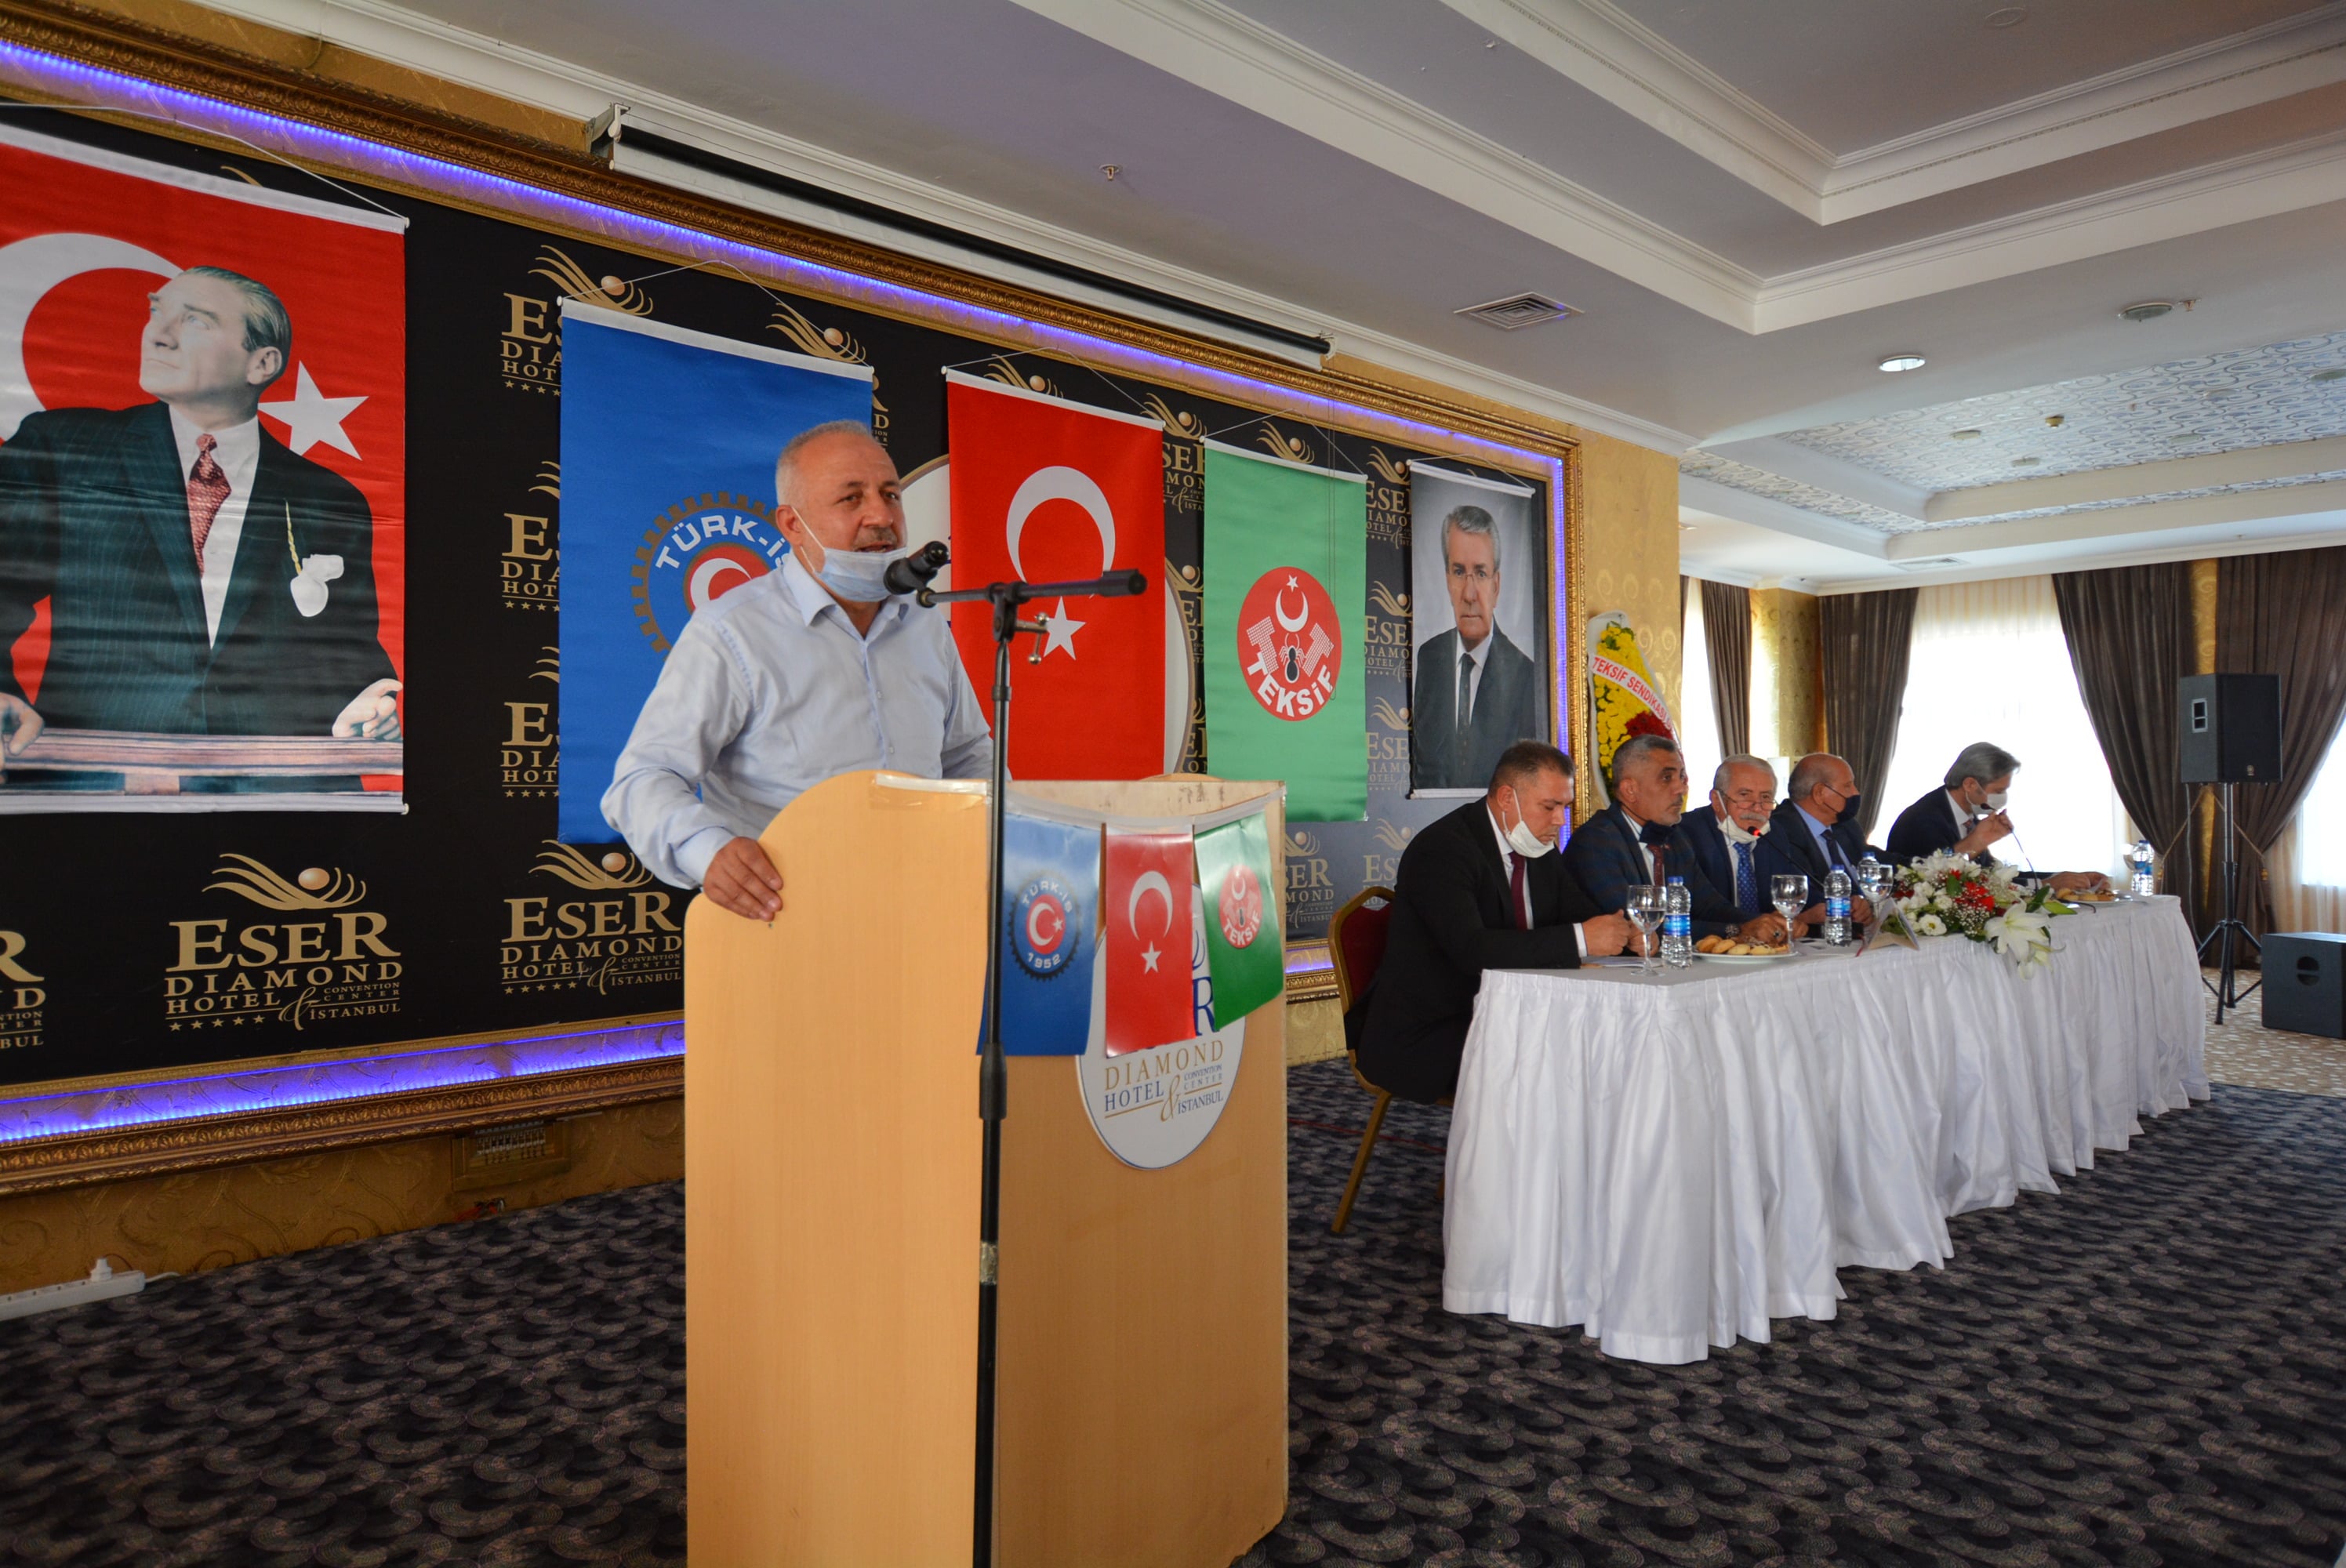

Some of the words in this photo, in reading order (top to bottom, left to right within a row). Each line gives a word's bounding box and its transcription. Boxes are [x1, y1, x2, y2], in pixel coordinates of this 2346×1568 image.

[502, 292, 561, 346] E
[500, 339, 561, 366] DIA
[502, 360, 557, 380] HOT
[1366, 480, 1411, 514] ESE
[1367, 521, 1392, 533] OTEL
[1368, 510, 1407, 527] IAMO
[502, 513, 560, 561] E
[502, 580, 557, 597] HOT
[1364, 615, 1413, 647] ESE
[1364, 645, 1407, 659] IAMO
[1367, 657, 1394, 667] OTEL
[1592, 656, 1629, 682] TEKSİF
[502, 702, 560, 746] E
[1367, 732, 1410, 760] ESE
[502, 770, 557, 782] HOT
[1367, 762, 1411, 773] IAMO
[1369, 774, 1396, 782] OTEL
[1286, 889, 1335, 903] MOND
[501, 891, 681, 943] ESER
[165, 912, 401, 972] ESER
[499, 935, 682, 964] DIAMOND
[622, 953, 681, 964] CONVENTION
[622, 960, 681, 970] CENTER
[1028, 953, 1061, 969] 1952
[502, 961, 589, 979] HOTEL
[164, 962, 402, 997] DIAMOND
[323, 982, 401, 994] CONVENTION
[0, 987, 46, 1009] D
[166, 992, 281, 1014] HOTEL
[323, 989, 401, 1002] CENTER
[0, 1019, 42, 1030] TER
[0, 1035, 44, 1049] BUL
[1105, 1040, 1223, 1091] DIAMOND
[1184, 1063, 1222, 1082] CONVENTION
[1184, 1073, 1222, 1091] CENTER
[1105, 1080, 1164, 1112] HOTEL
